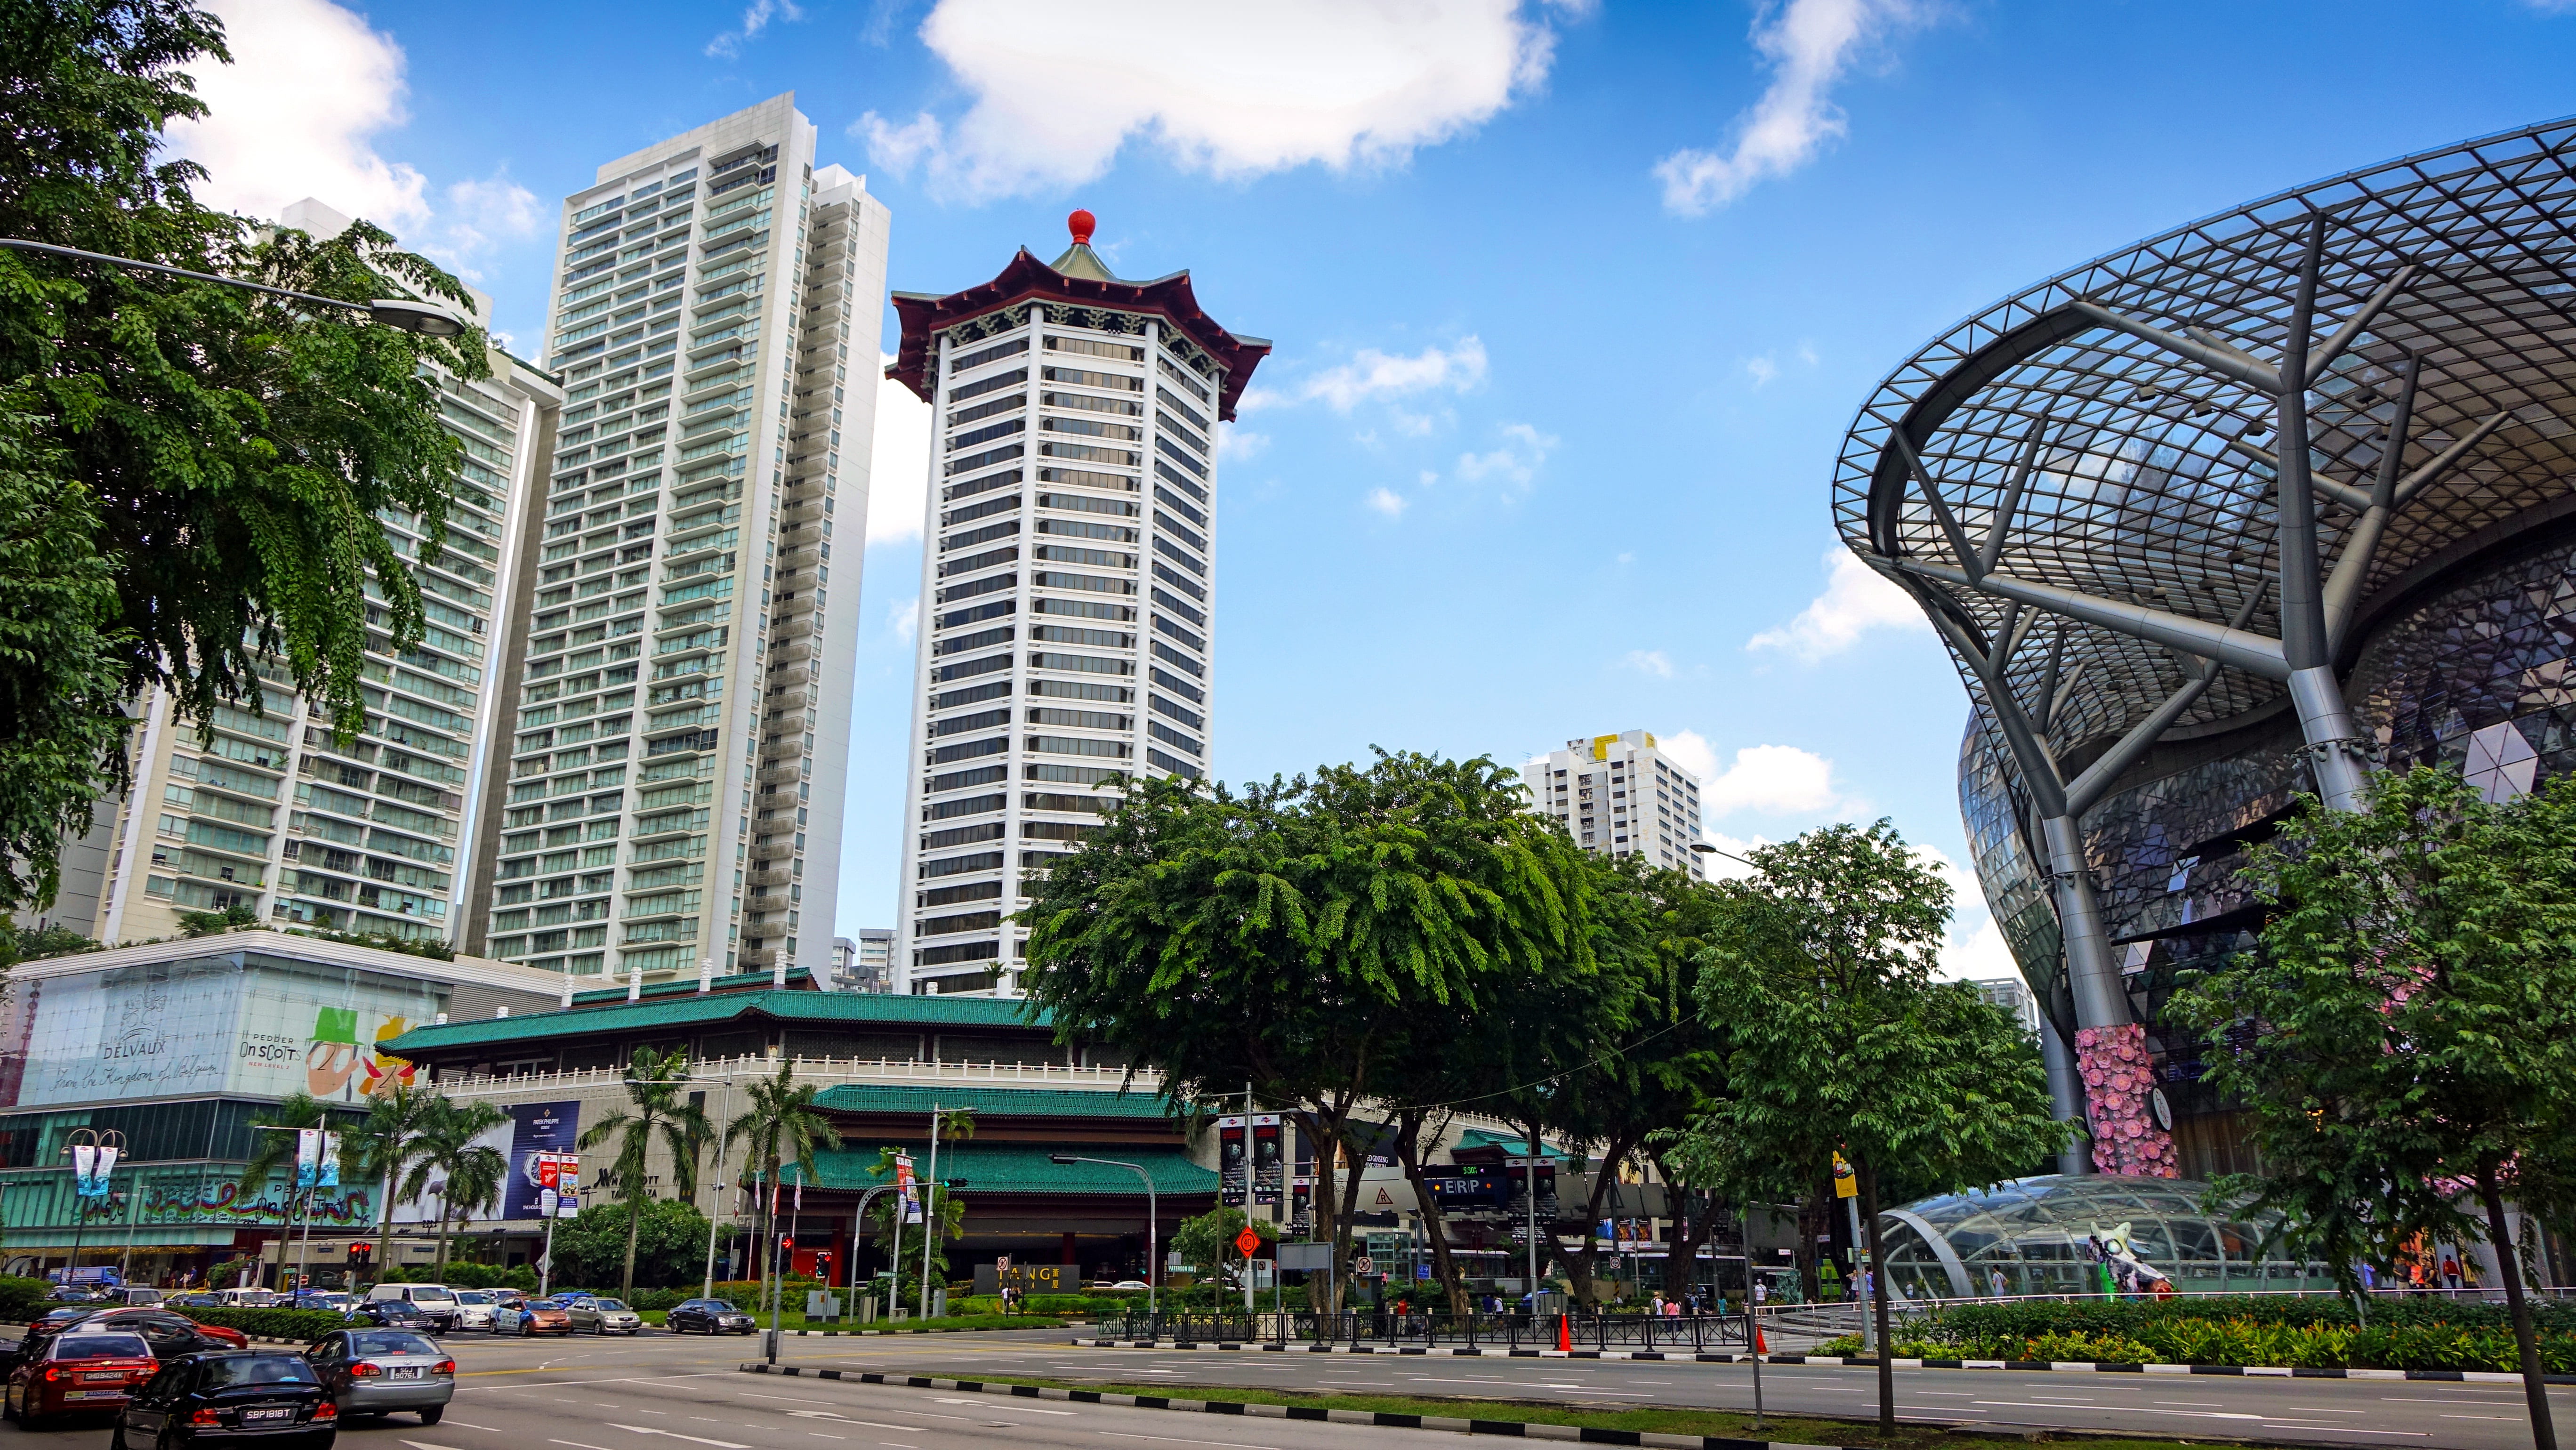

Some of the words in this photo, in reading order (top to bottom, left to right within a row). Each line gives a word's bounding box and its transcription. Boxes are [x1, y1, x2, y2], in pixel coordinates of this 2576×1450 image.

[253, 1034, 294, 1044] PEDDER
[103, 1041, 166, 1060] DELVAUX
[82, 1067, 97, 1089] the
[97, 1066, 153, 1096] Kingdom
[153, 1062, 171, 1096] of
[173, 1055, 219, 1086] Belgium
[1372, 1155, 1388, 1163] GINSENG
[1244, 1238, 1251, 1247] 40
